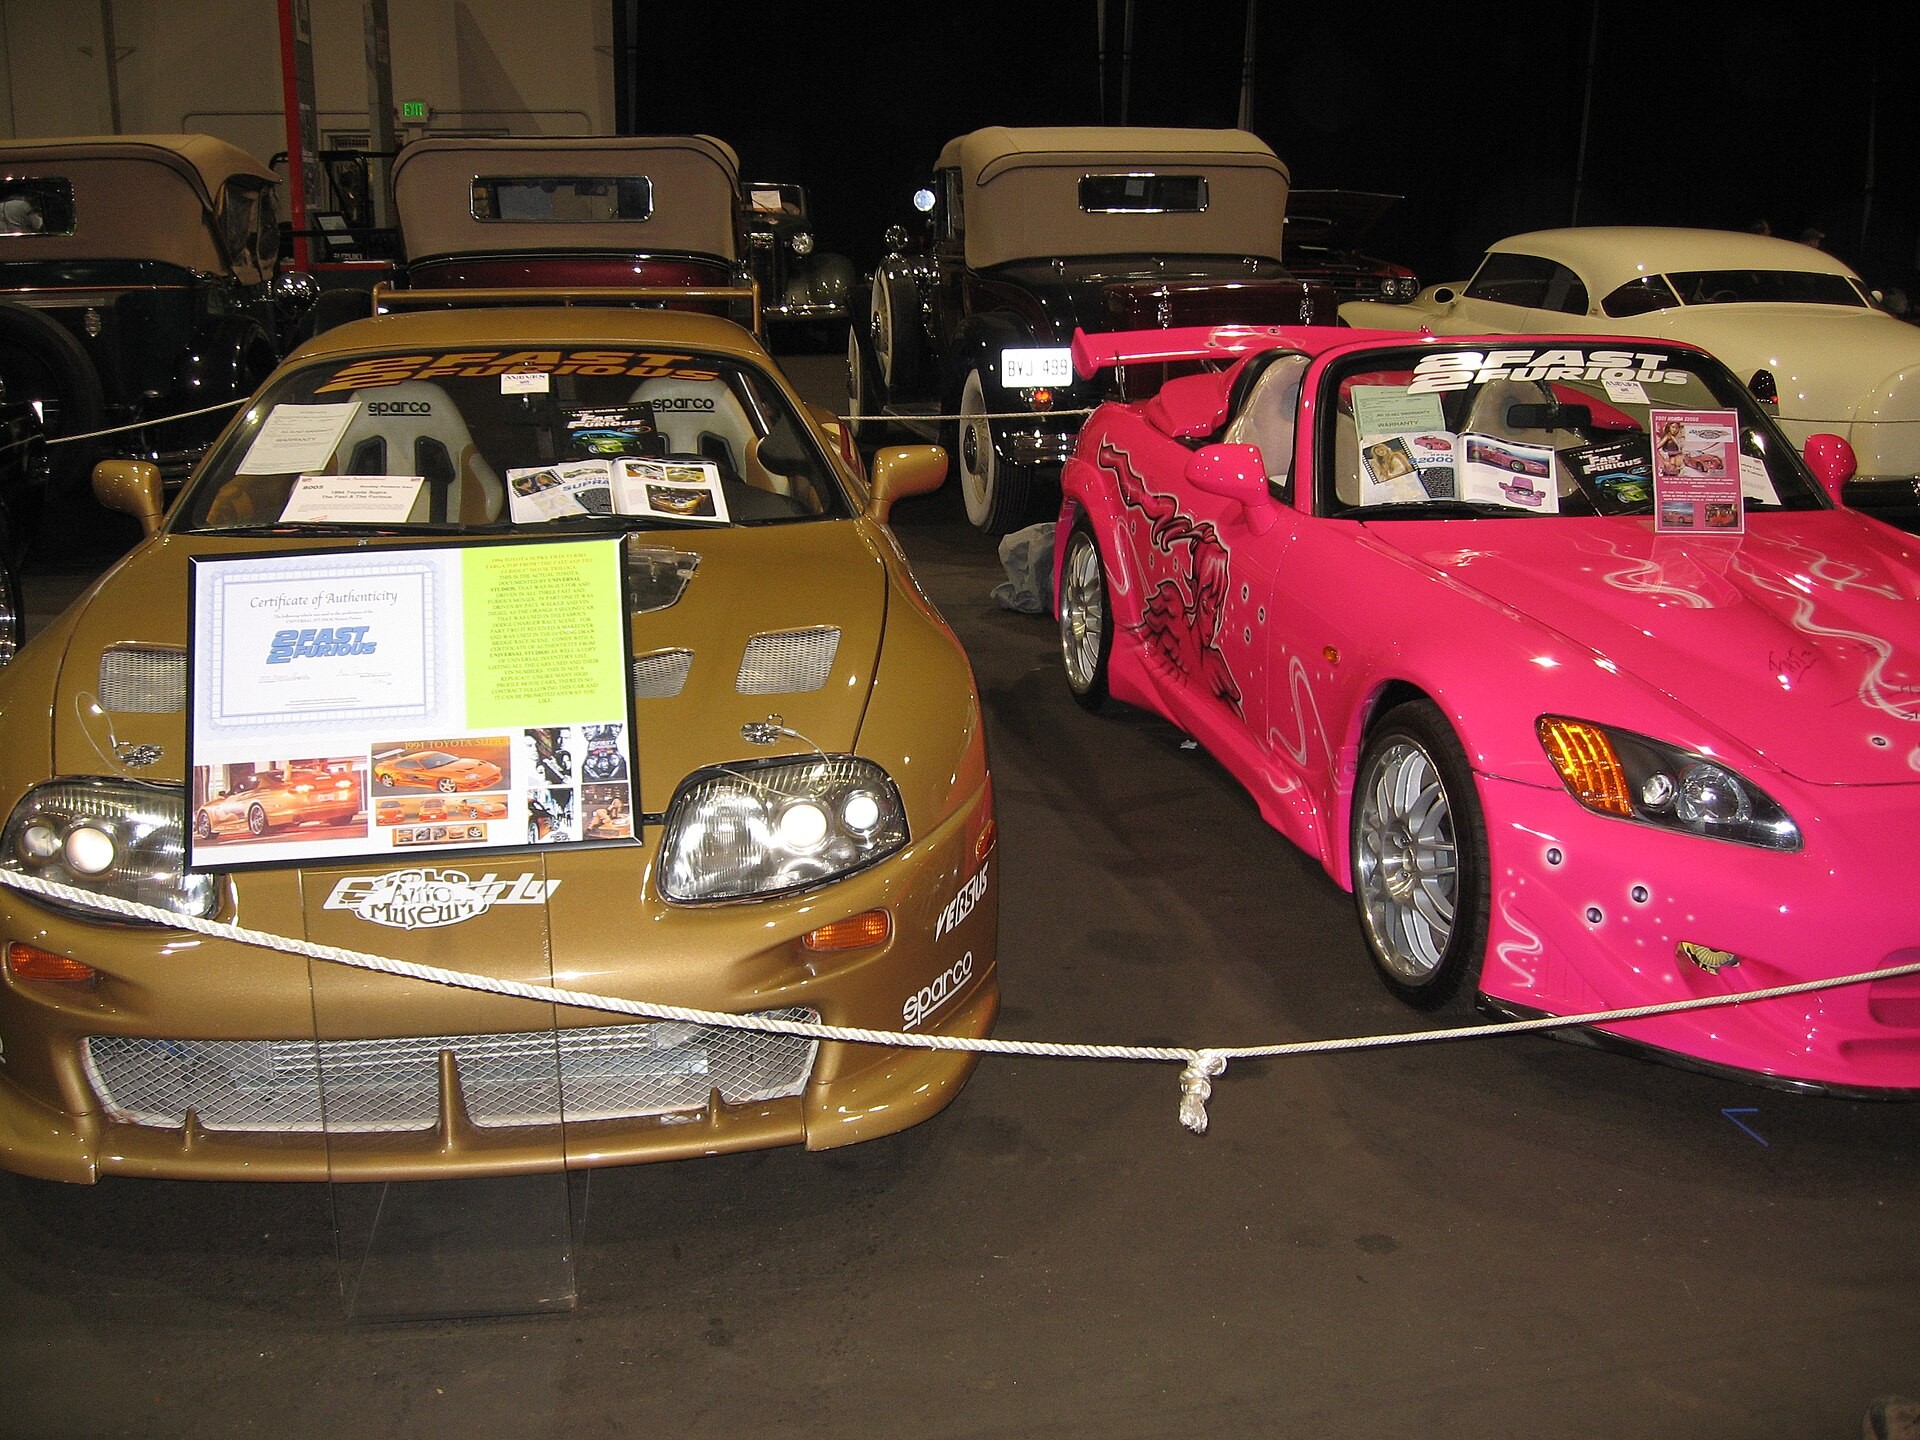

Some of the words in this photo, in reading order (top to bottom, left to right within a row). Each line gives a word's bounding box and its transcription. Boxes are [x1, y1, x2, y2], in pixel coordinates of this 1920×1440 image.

[404, 102, 423, 117] EXIT
[368, 400, 431, 415] sparco
[652, 397, 715, 412] sparco
[567, 419, 643, 429] FURIOUS
[1583, 456, 1643, 475] FURIOUS
[563, 480, 609, 491] SUPRA
[250, 592, 309, 612] Certificate
[312, 591, 326, 610] of
[325, 589, 398, 606] Authenticity
[429, 739, 473, 749] TOYOTA
[934, 860, 989, 943] VERSUS
[903, 950, 973, 1027] sparco
